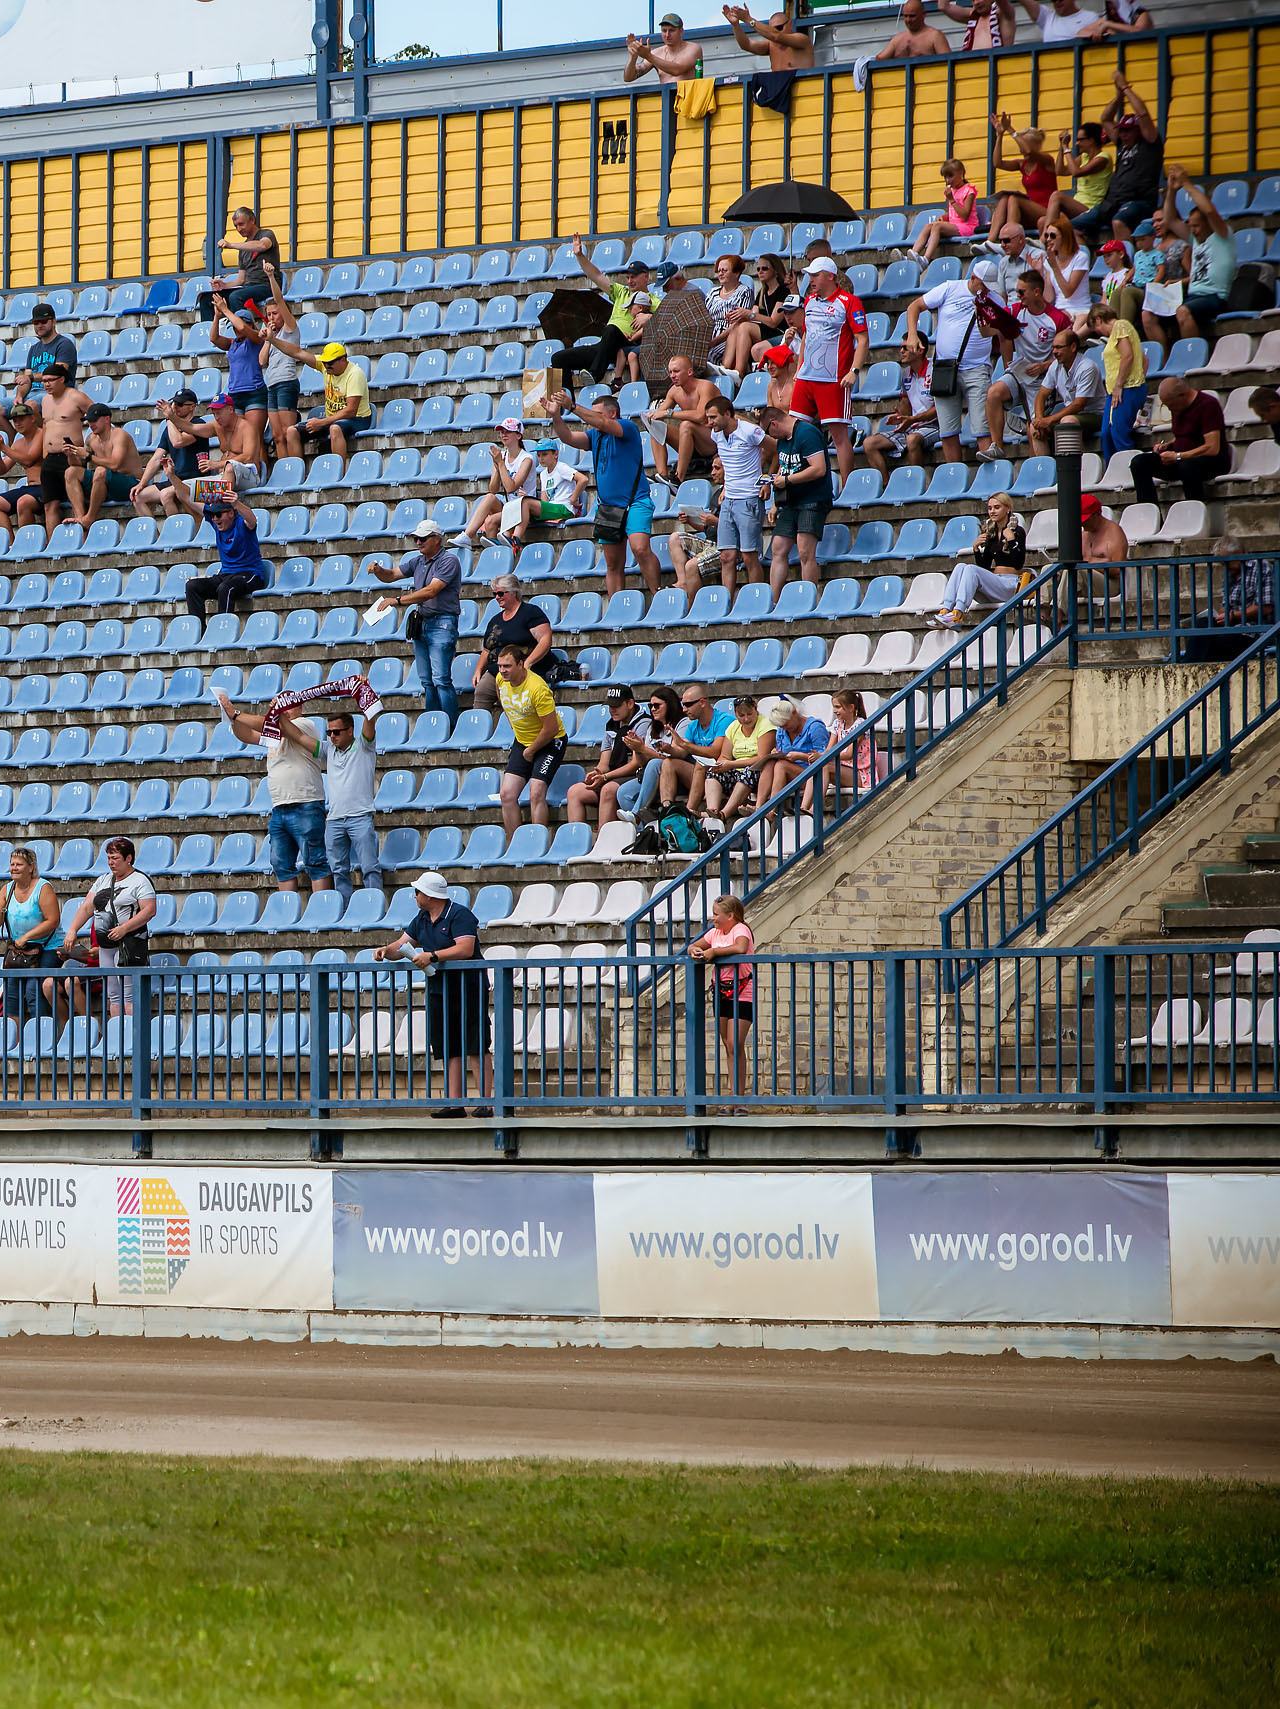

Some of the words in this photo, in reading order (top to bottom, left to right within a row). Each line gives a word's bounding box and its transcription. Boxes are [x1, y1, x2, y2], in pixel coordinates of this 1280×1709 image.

[869, 320, 877, 329] 15
[540, 754, 554, 775] BOSS
[199, 1181, 313, 1213] DAUGAVPILS
[35, 1220, 66, 1249] PILS
[200, 1224, 214, 1253] IR
[219, 1225, 278, 1256] SPORTS
[364, 1221, 563, 1264] www.gorod.lv
[629, 1223, 839, 1268] www.gorod.lv
[909, 1223, 1132, 1271] www.gorod.lv
